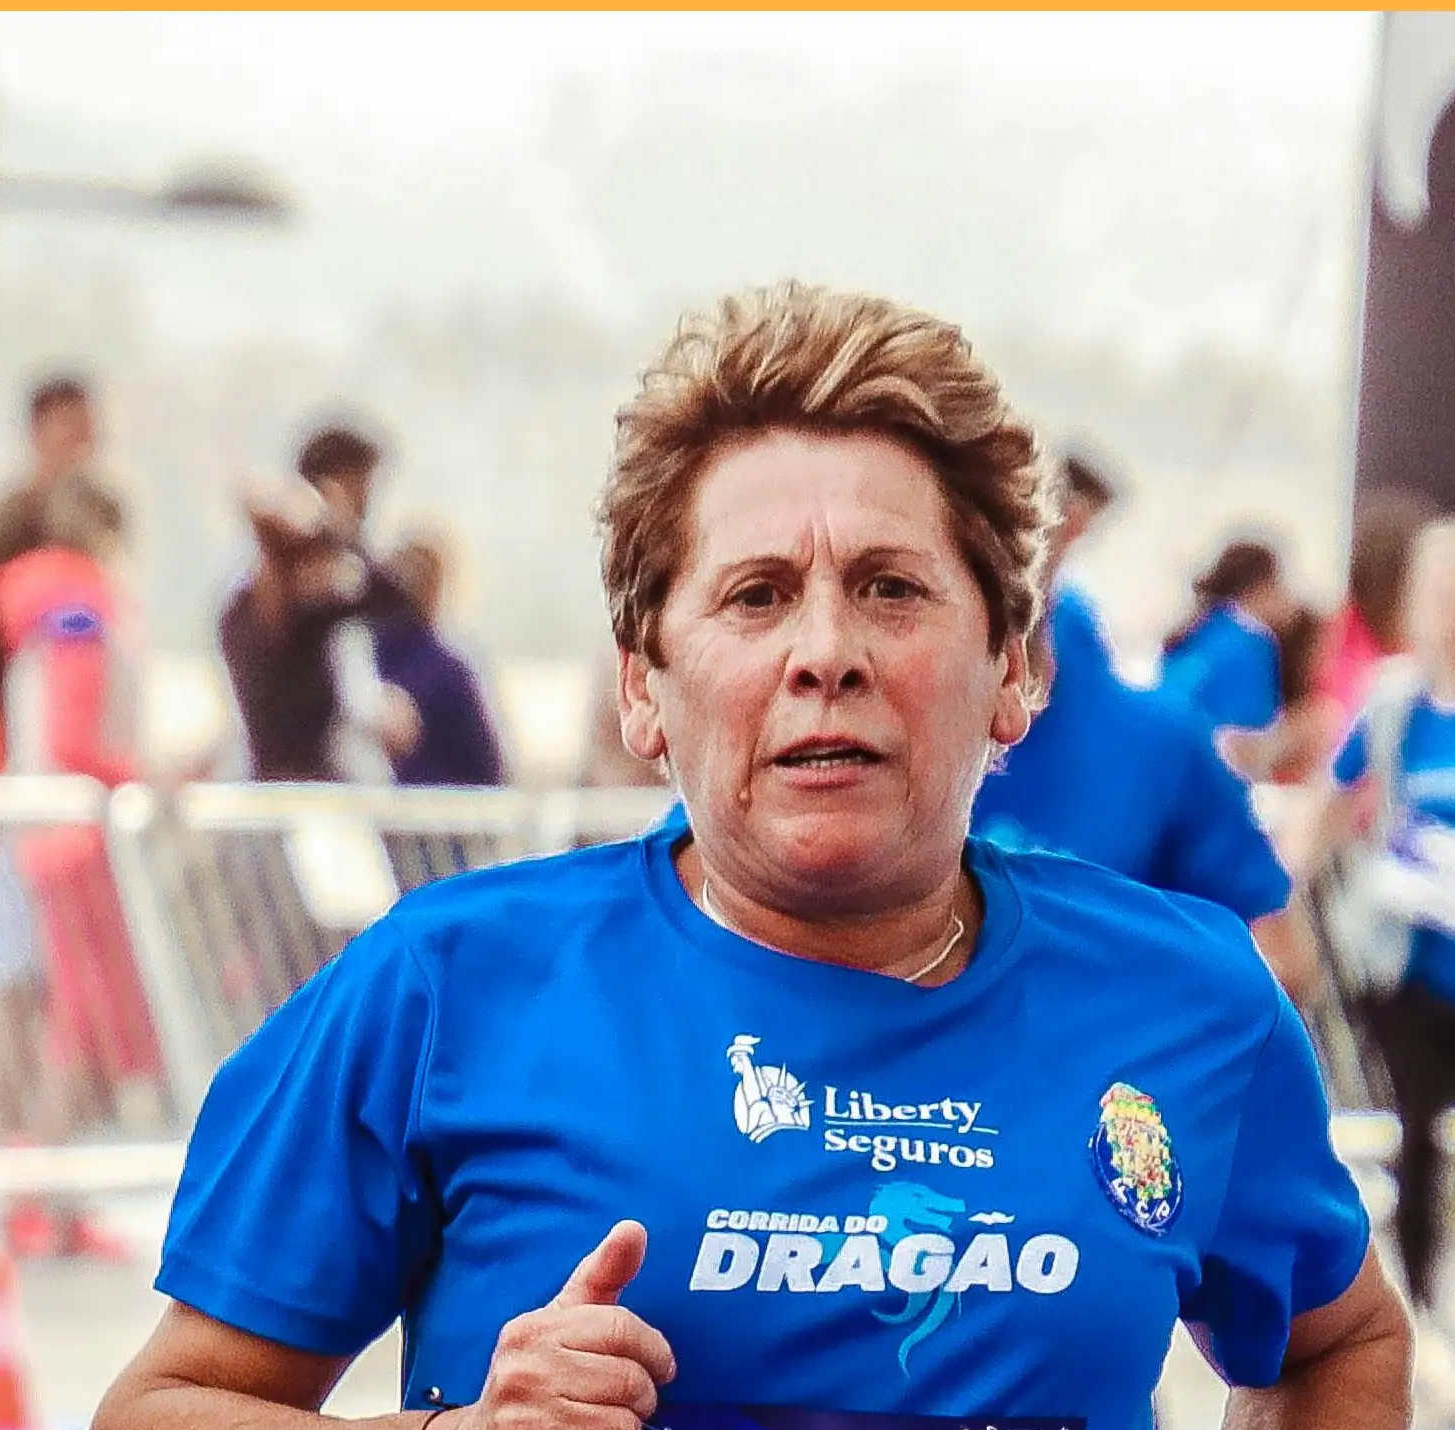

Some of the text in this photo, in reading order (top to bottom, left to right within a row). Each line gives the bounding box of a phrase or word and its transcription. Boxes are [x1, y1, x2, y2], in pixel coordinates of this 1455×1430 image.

[824, 1086, 982, 1132] Liberty
[824, 1128, 994, 1171] Seguros
[706, 1209, 887, 1233] CORRIDA DO
[689, 1211, 1079, 1294] DRAGÃO
